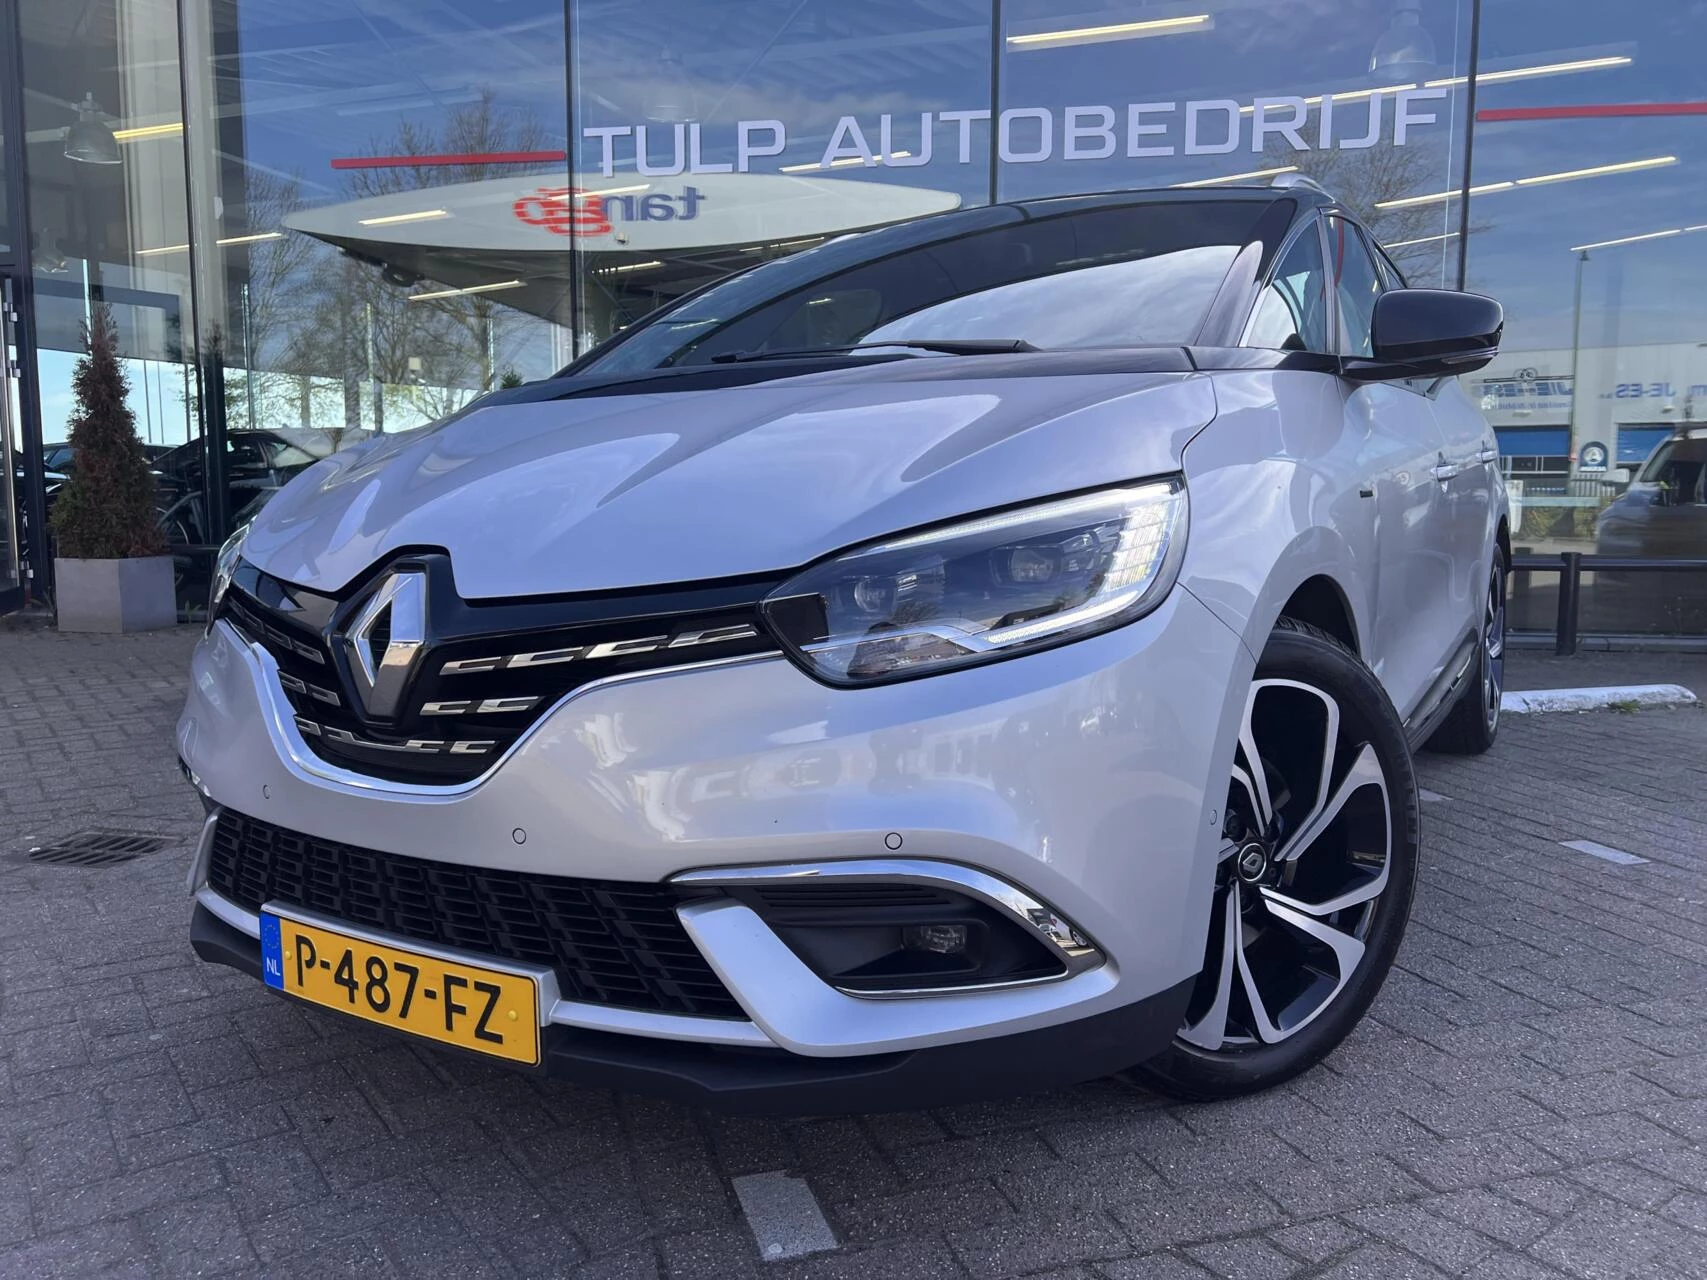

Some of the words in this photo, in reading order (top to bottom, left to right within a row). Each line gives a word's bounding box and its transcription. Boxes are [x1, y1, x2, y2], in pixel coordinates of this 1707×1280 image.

[583, 118, 787, 178] TULP
[820, 87, 1448, 169] AUTOBEDRIJF
[266, 956, 281, 977] NL
[295, 934, 504, 1045] P-487-FZ
